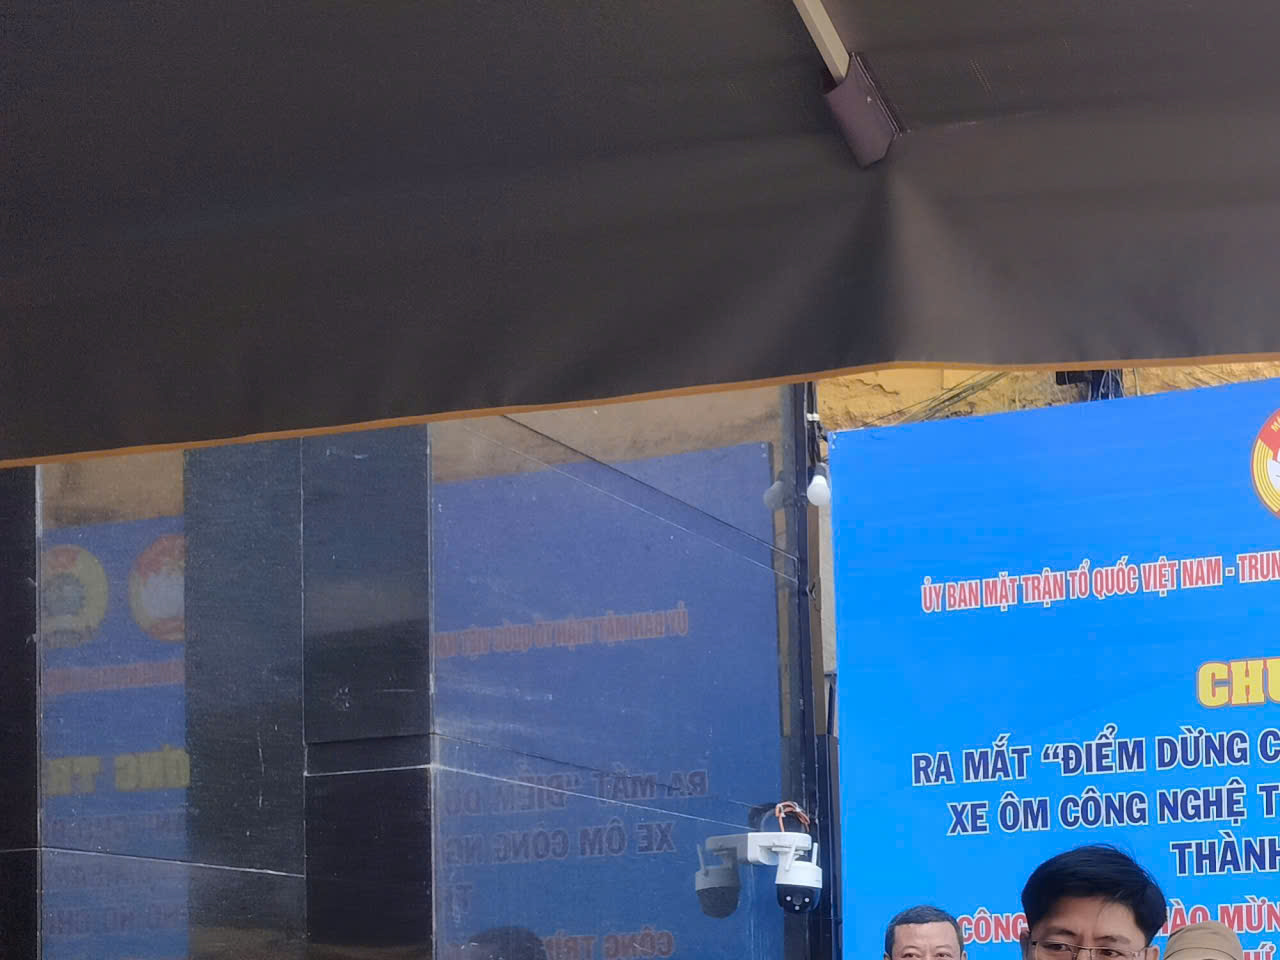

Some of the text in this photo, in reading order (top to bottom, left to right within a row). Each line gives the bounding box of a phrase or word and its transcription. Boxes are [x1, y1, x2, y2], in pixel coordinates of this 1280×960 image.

[921, 576, 943, 612] ỦY
[946, 579, 980, 611] BAN
[983, 571, 1018, 611] MẶT
[1021, 568, 1065, 606] TRẬN
[1068, 559, 1090, 599] TỔ
[1093, 556, 1138, 599] QUỐC
[1141, 556, 1178, 596] VIỆT
[1181, 556, 1223, 588] NAM
[912, 752, 955, 786] RA
[963, 733, 1032, 784] MẮT
[1155, 725, 1250, 770] DỪNG
[946, 800, 990, 836] XE
[998, 791, 1051, 832] ÔM
[1059, 786, 1148, 828] CÔNG
[1157, 778, 1246, 827] NGHỆ
[957, 907, 1028, 944] CÔNG
